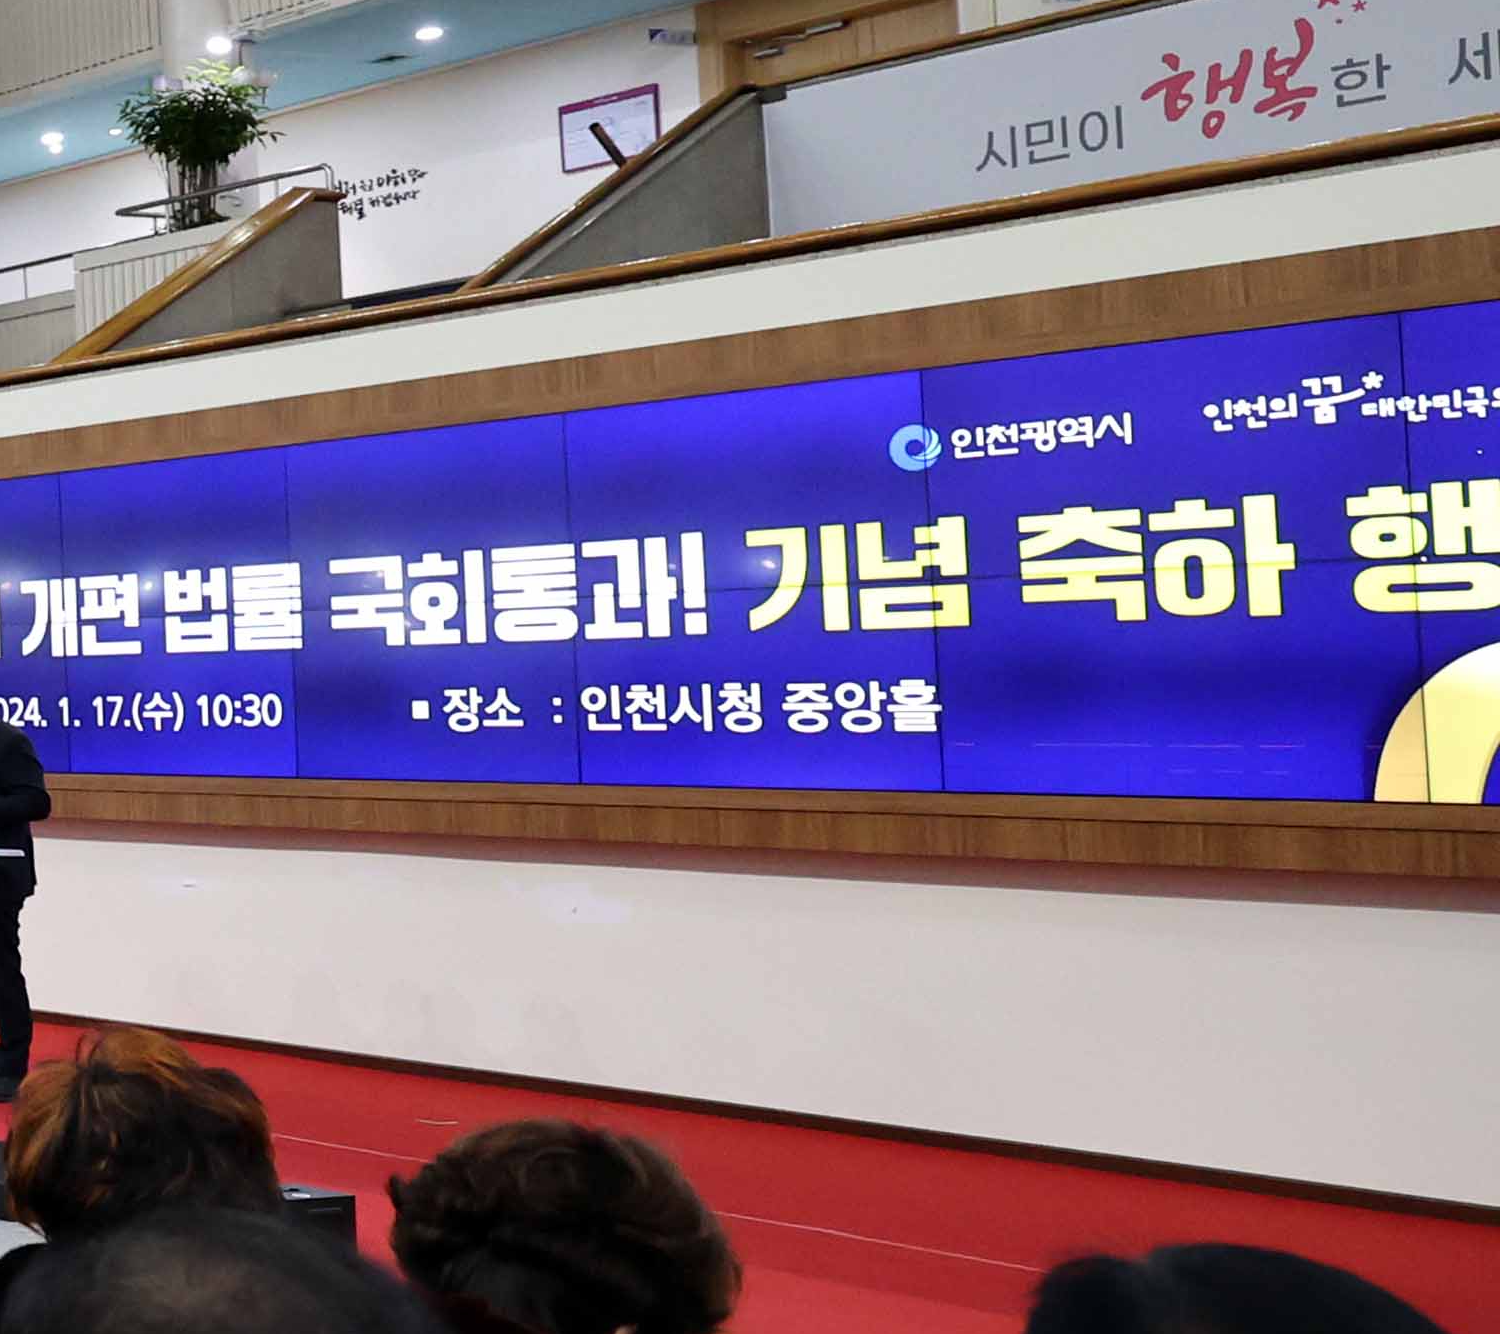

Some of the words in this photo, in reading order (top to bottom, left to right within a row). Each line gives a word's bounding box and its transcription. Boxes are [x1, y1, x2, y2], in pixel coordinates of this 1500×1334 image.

[976, 105, 1124, 171] 시민이
[1140, 17, 1392, 139] 행복한
[951, 412, 1133, 459] 인천광역시
[1203, 392, 1298, 432] 인천의
[21, 573, 143, 657] 개편
[164, 562, 303, 654] 법률
[328, 531, 708, 646] 국회통과!
[745, 516, 970, 631] 기념
[1017, 494, 1296, 621] 축하
[58, 697, 81, 727] 1.
[92, 691, 184, 732] 17.(수)
[196, 693, 283, 727] 10:30
[442, 687, 524, 733] 장소
[580, 682, 763, 733] 인천시청
[782, 679, 942, 733] 중앙홀
